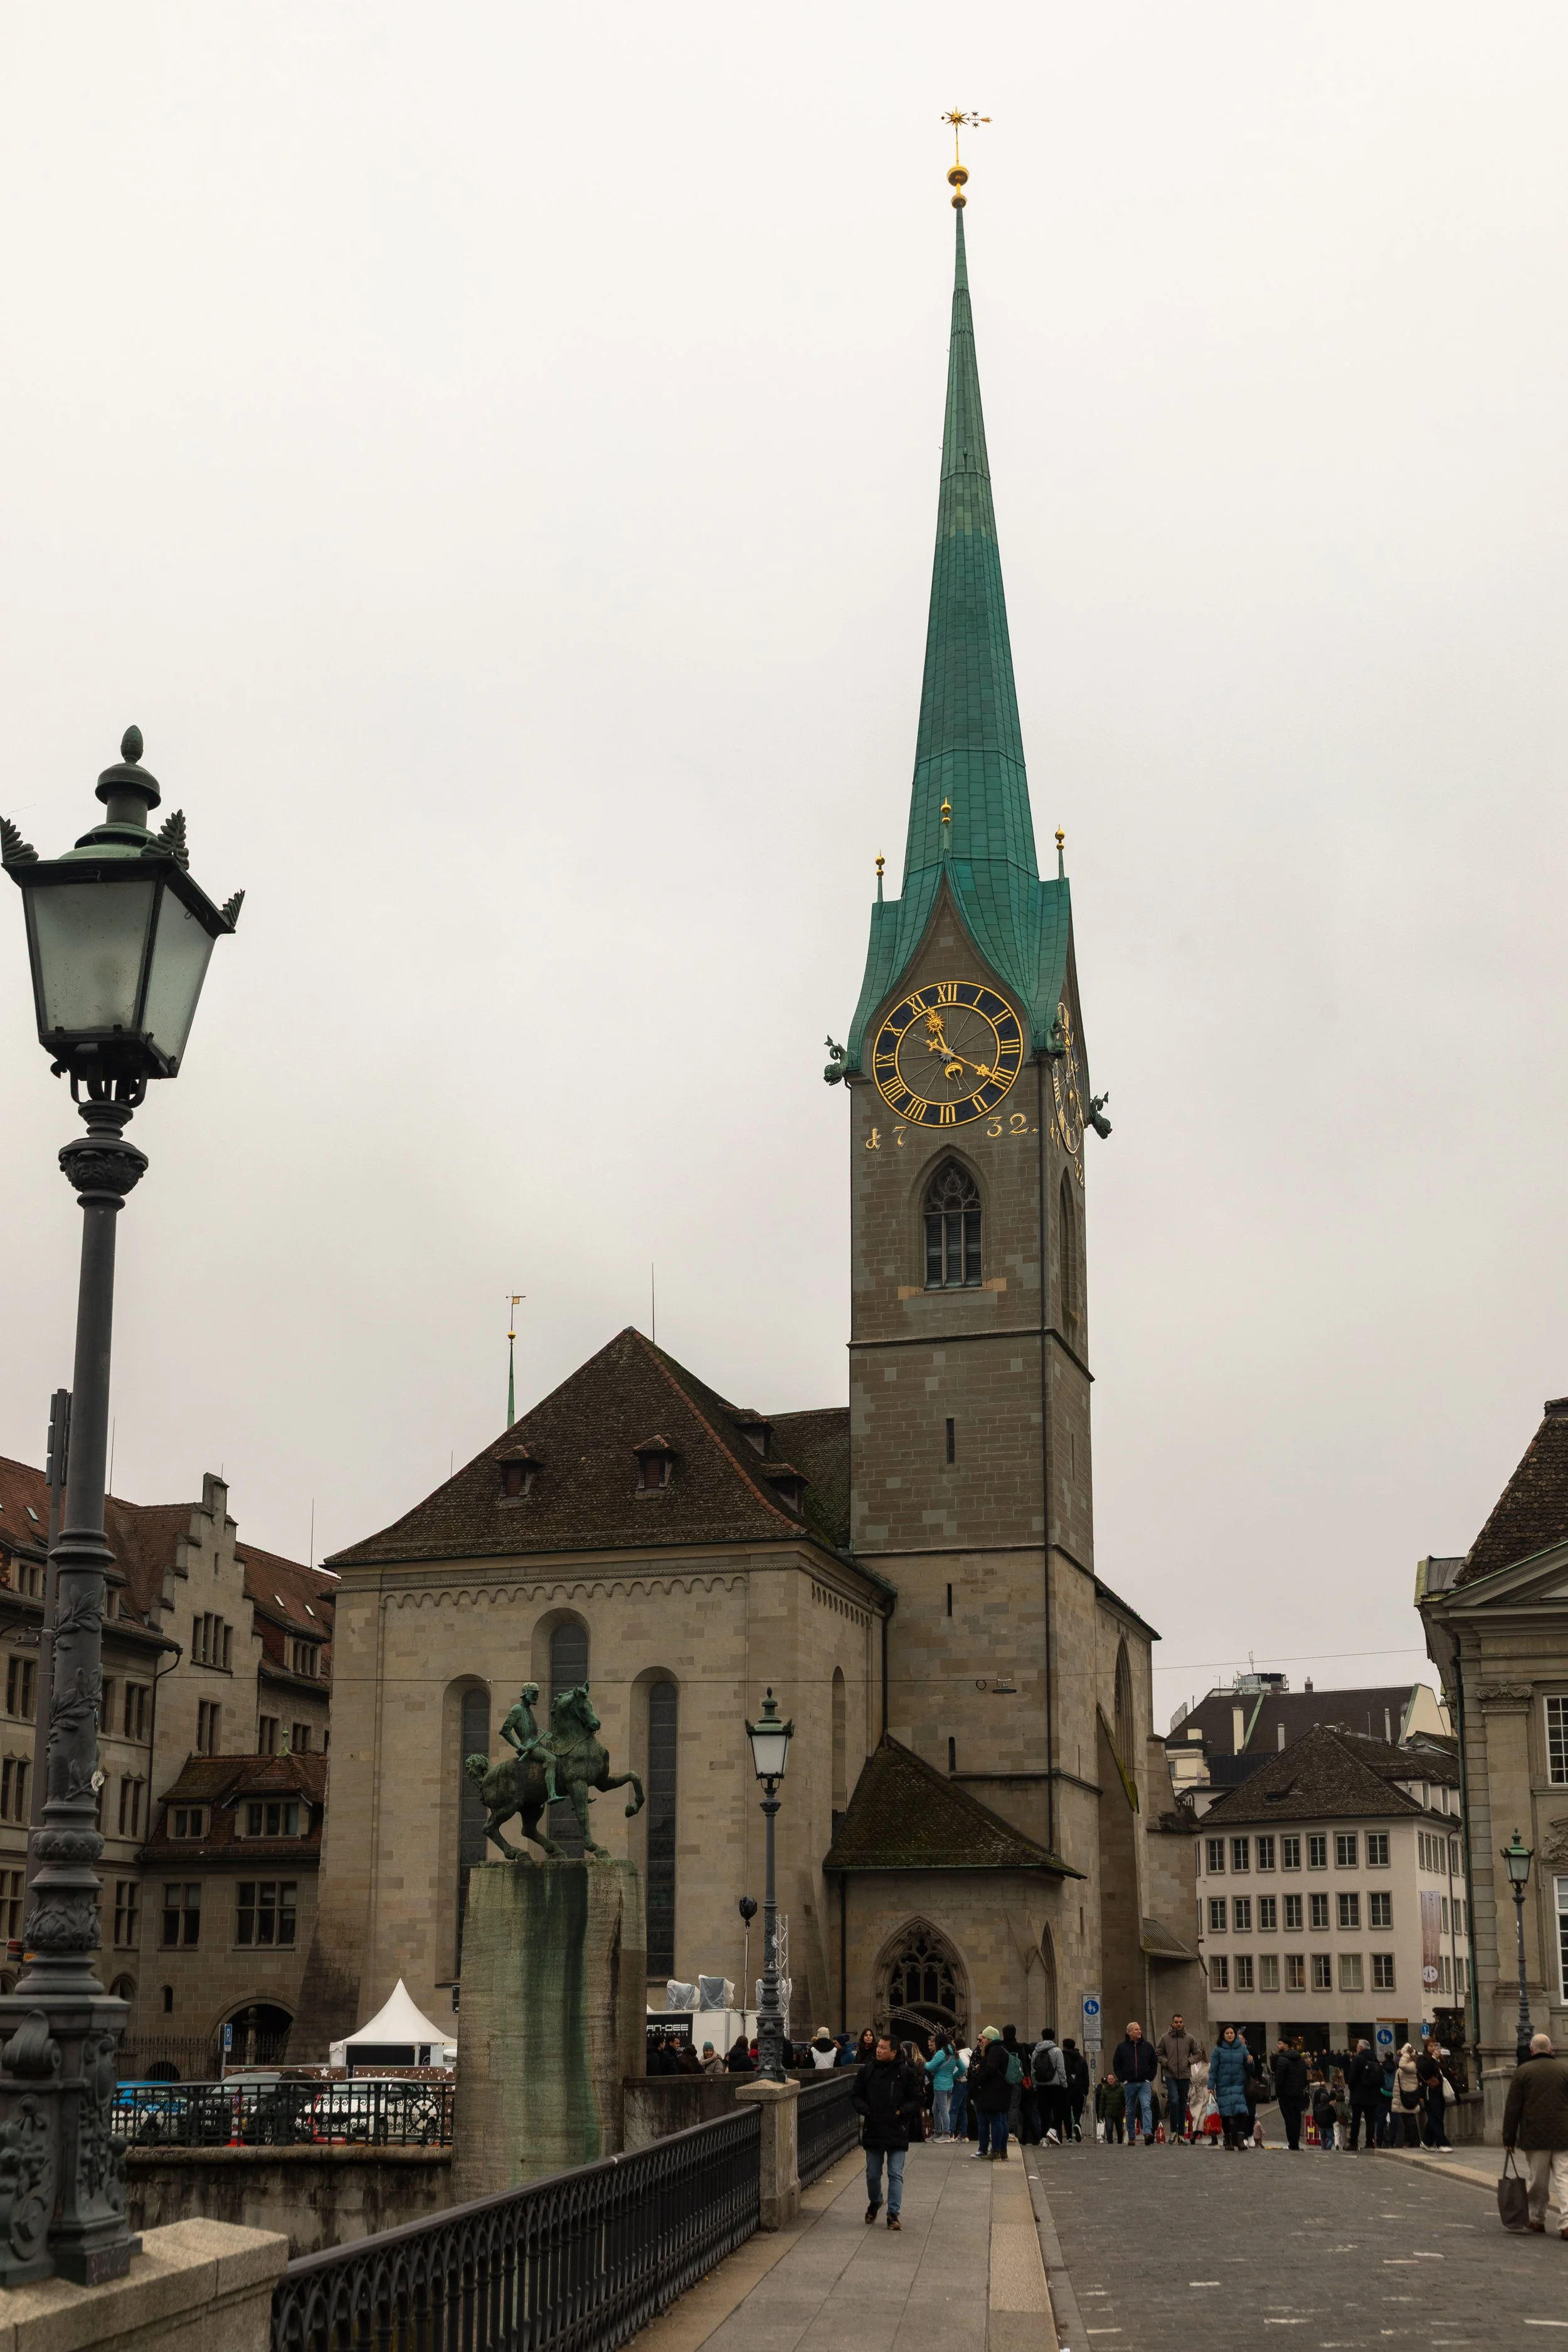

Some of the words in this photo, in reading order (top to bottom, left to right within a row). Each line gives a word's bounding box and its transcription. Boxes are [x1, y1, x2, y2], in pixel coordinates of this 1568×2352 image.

[936, 983, 958, 1004] XII
[906, 994, 926, 1015] XI
[992, 1009, 1012, 1026] II
[884, 1022, 903, 1036] X
[1000, 1039, 1020, 1054] III
